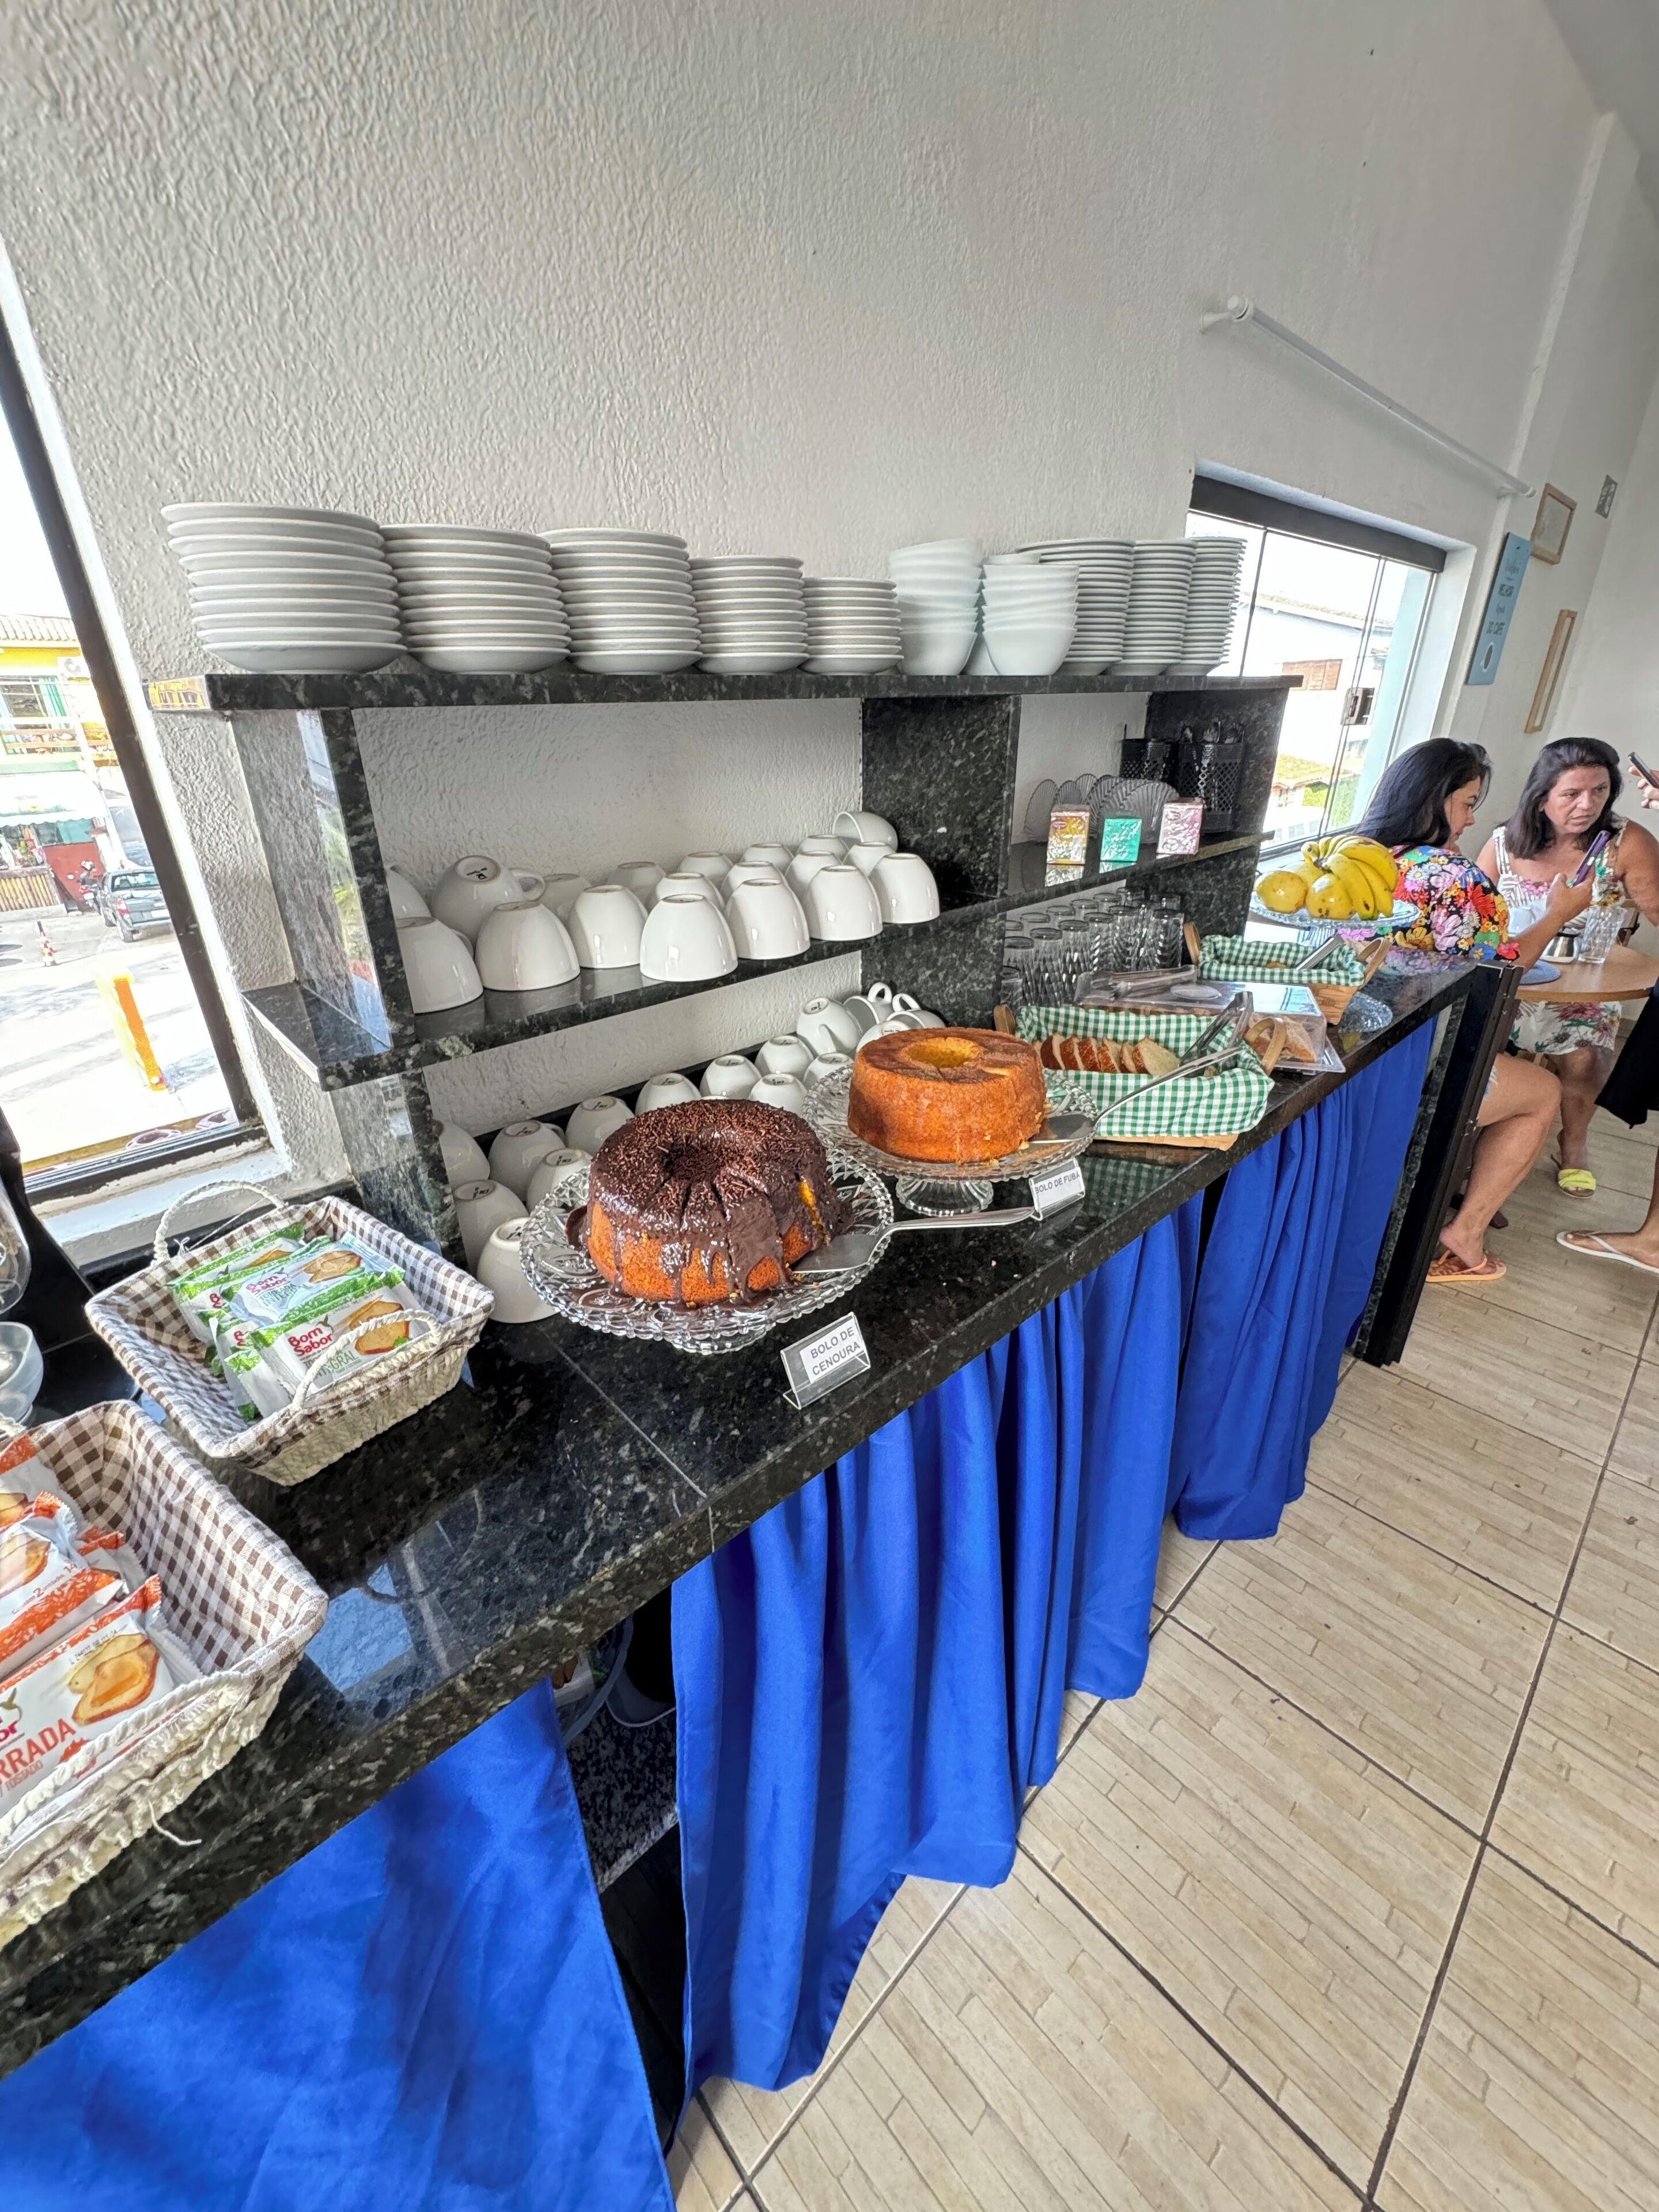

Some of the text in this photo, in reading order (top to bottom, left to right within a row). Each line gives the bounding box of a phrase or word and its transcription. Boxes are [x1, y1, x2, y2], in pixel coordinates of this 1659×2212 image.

[1035, 1181, 1053, 1194] BOLO
[1054, 1178, 1063, 1188] DE
[246, 1275, 279, 1291] Bom
[287, 1327, 324, 1347] Bom
[294, 1333, 333, 1357] Sabor
[810, 1327, 855, 1359] BOLO DE
[812, 1341, 861, 1376] CENOURA
